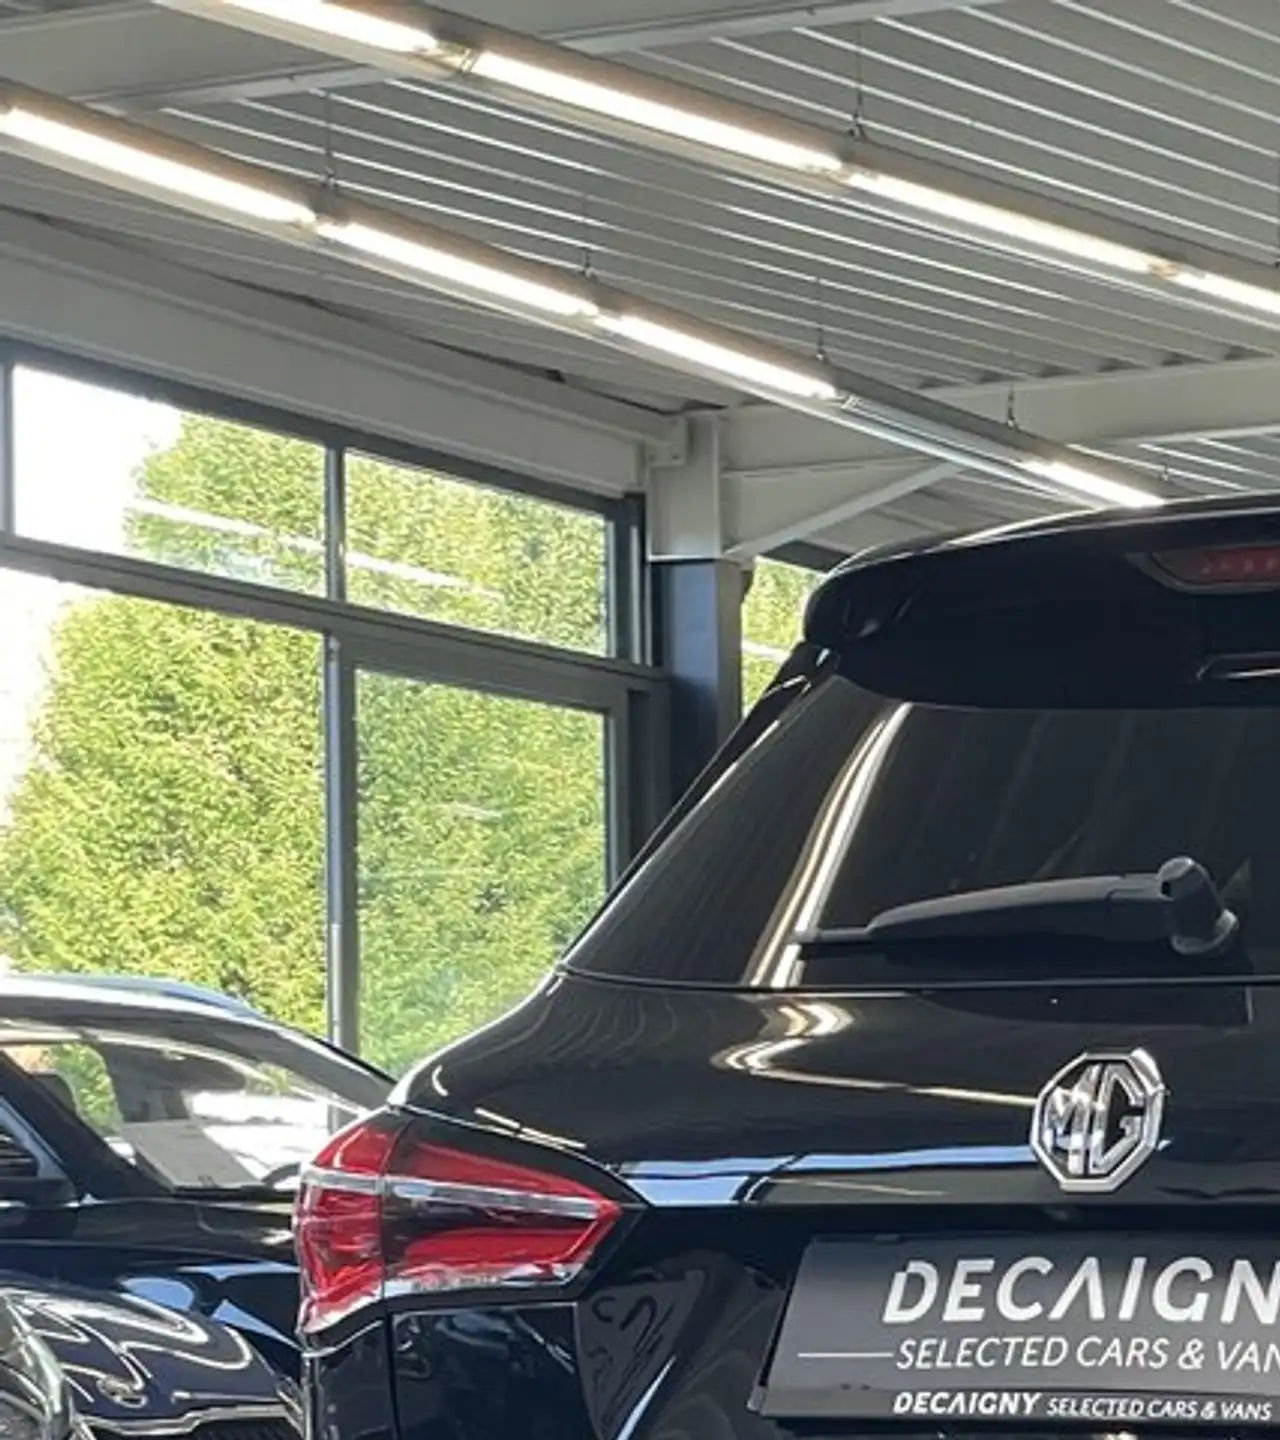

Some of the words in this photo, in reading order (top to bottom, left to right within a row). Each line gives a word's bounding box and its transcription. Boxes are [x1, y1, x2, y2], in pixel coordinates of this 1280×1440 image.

[1043, 1062, 1145, 1174] MG
[896, 1335, 1068, 1370] SELECTED
[1075, 1337, 1170, 1370] CARS
[1177, 1339, 1204, 1370] &
[891, 1391, 1043, 1415] DECAIGNY
[1045, 1396, 1144, 1418] SELECTED
[1145, 1399, 1199, 1419] CARS
[1200, 1402, 1216, 1420] &
[1219, 1402, 1273, 1421] VANS
